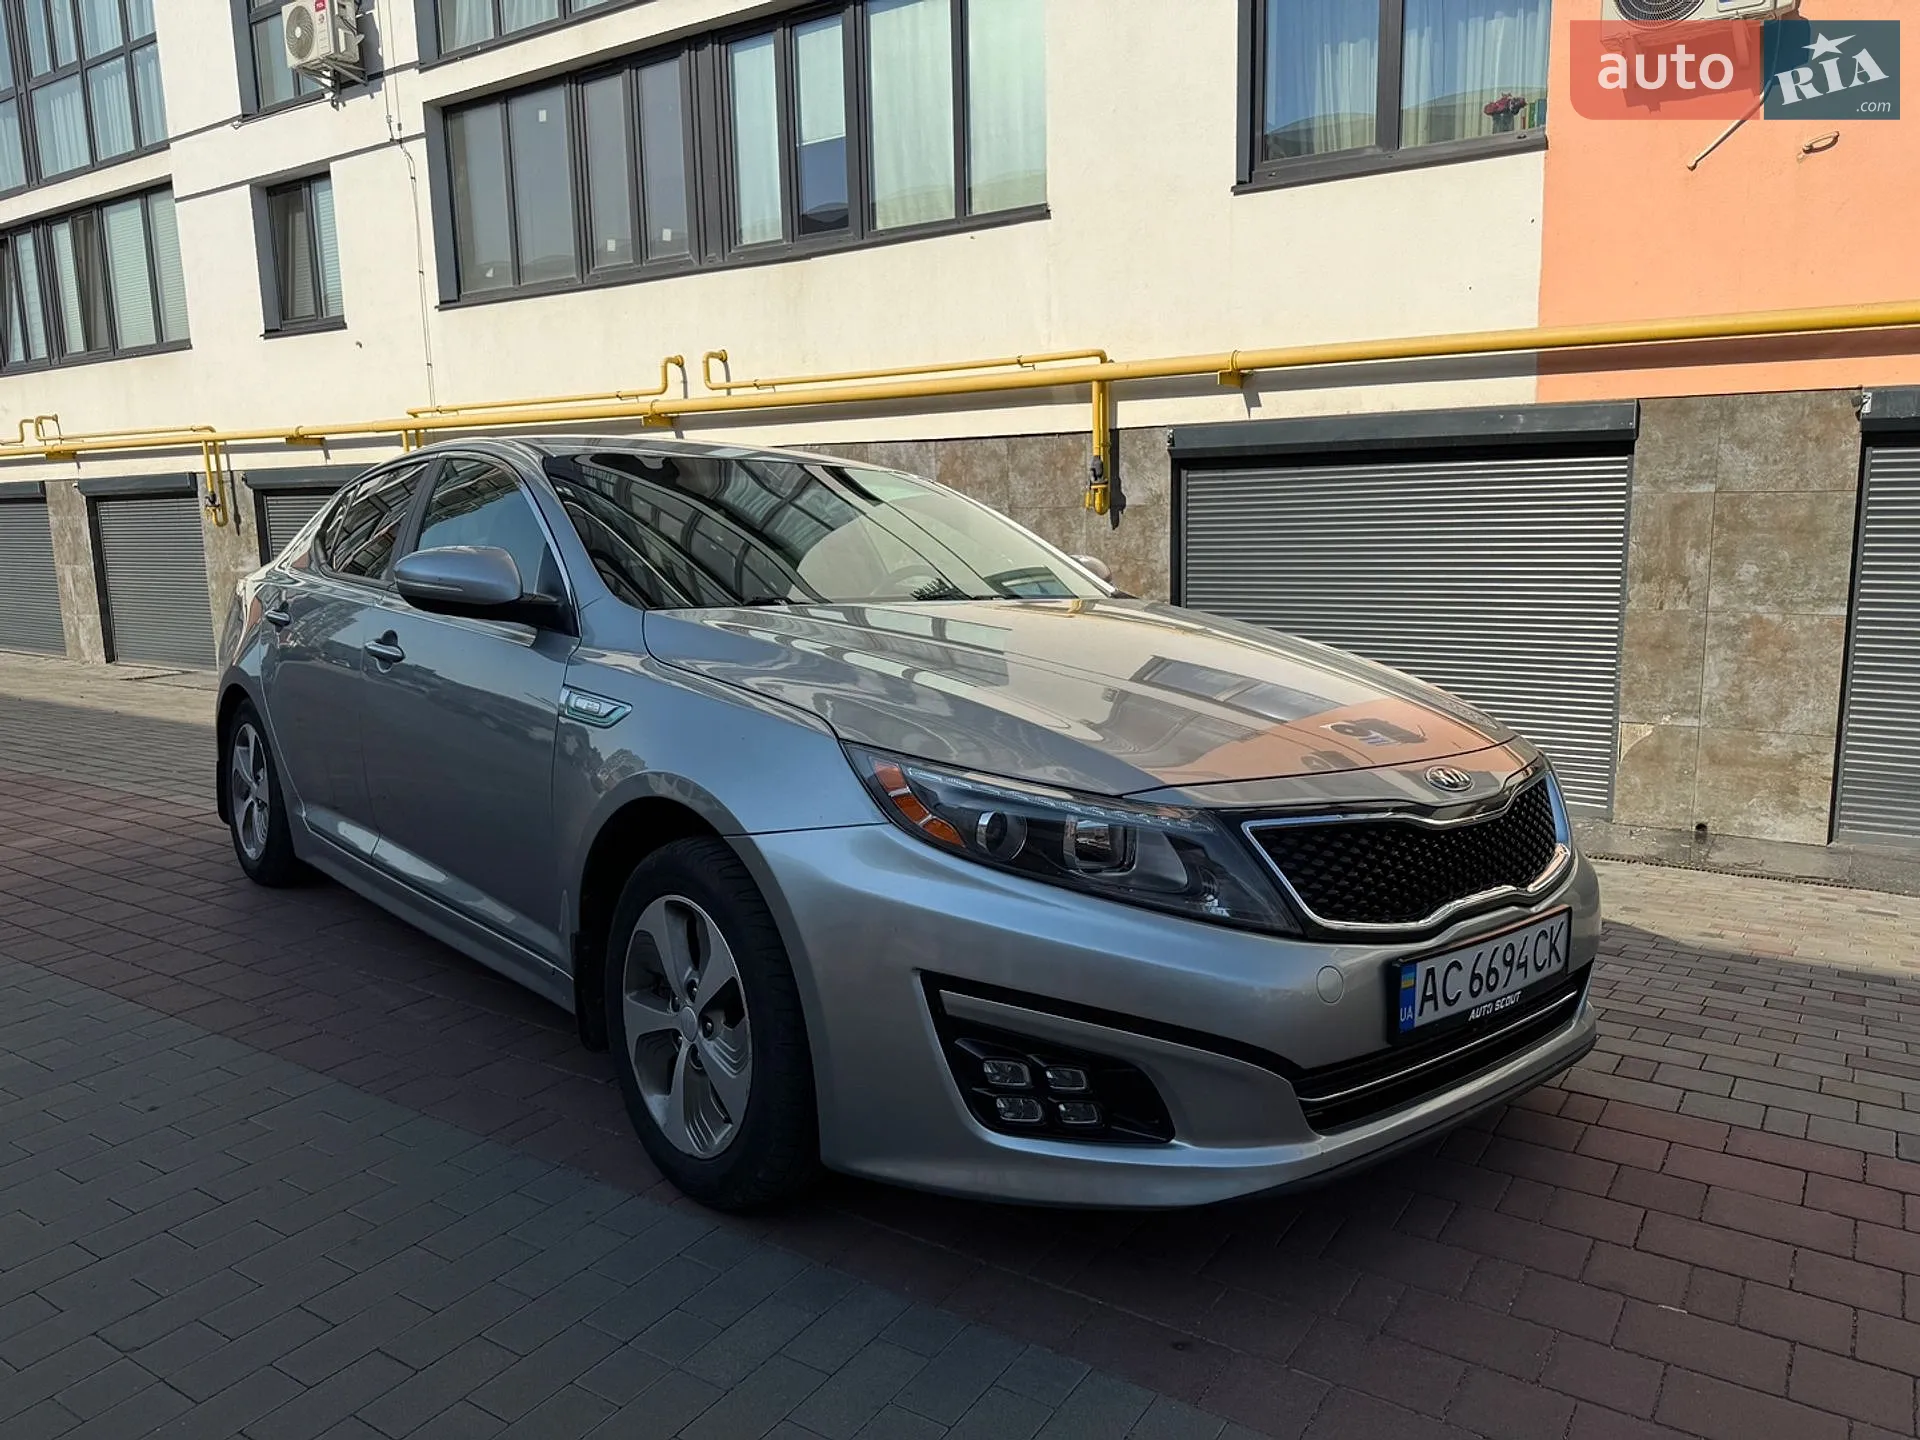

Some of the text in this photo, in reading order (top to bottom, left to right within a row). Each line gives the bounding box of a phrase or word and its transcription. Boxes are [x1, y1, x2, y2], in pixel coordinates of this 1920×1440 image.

[1400, 1007, 1413, 1021] UA
[1468, 991, 1522, 1021] AUTO SCOUT
